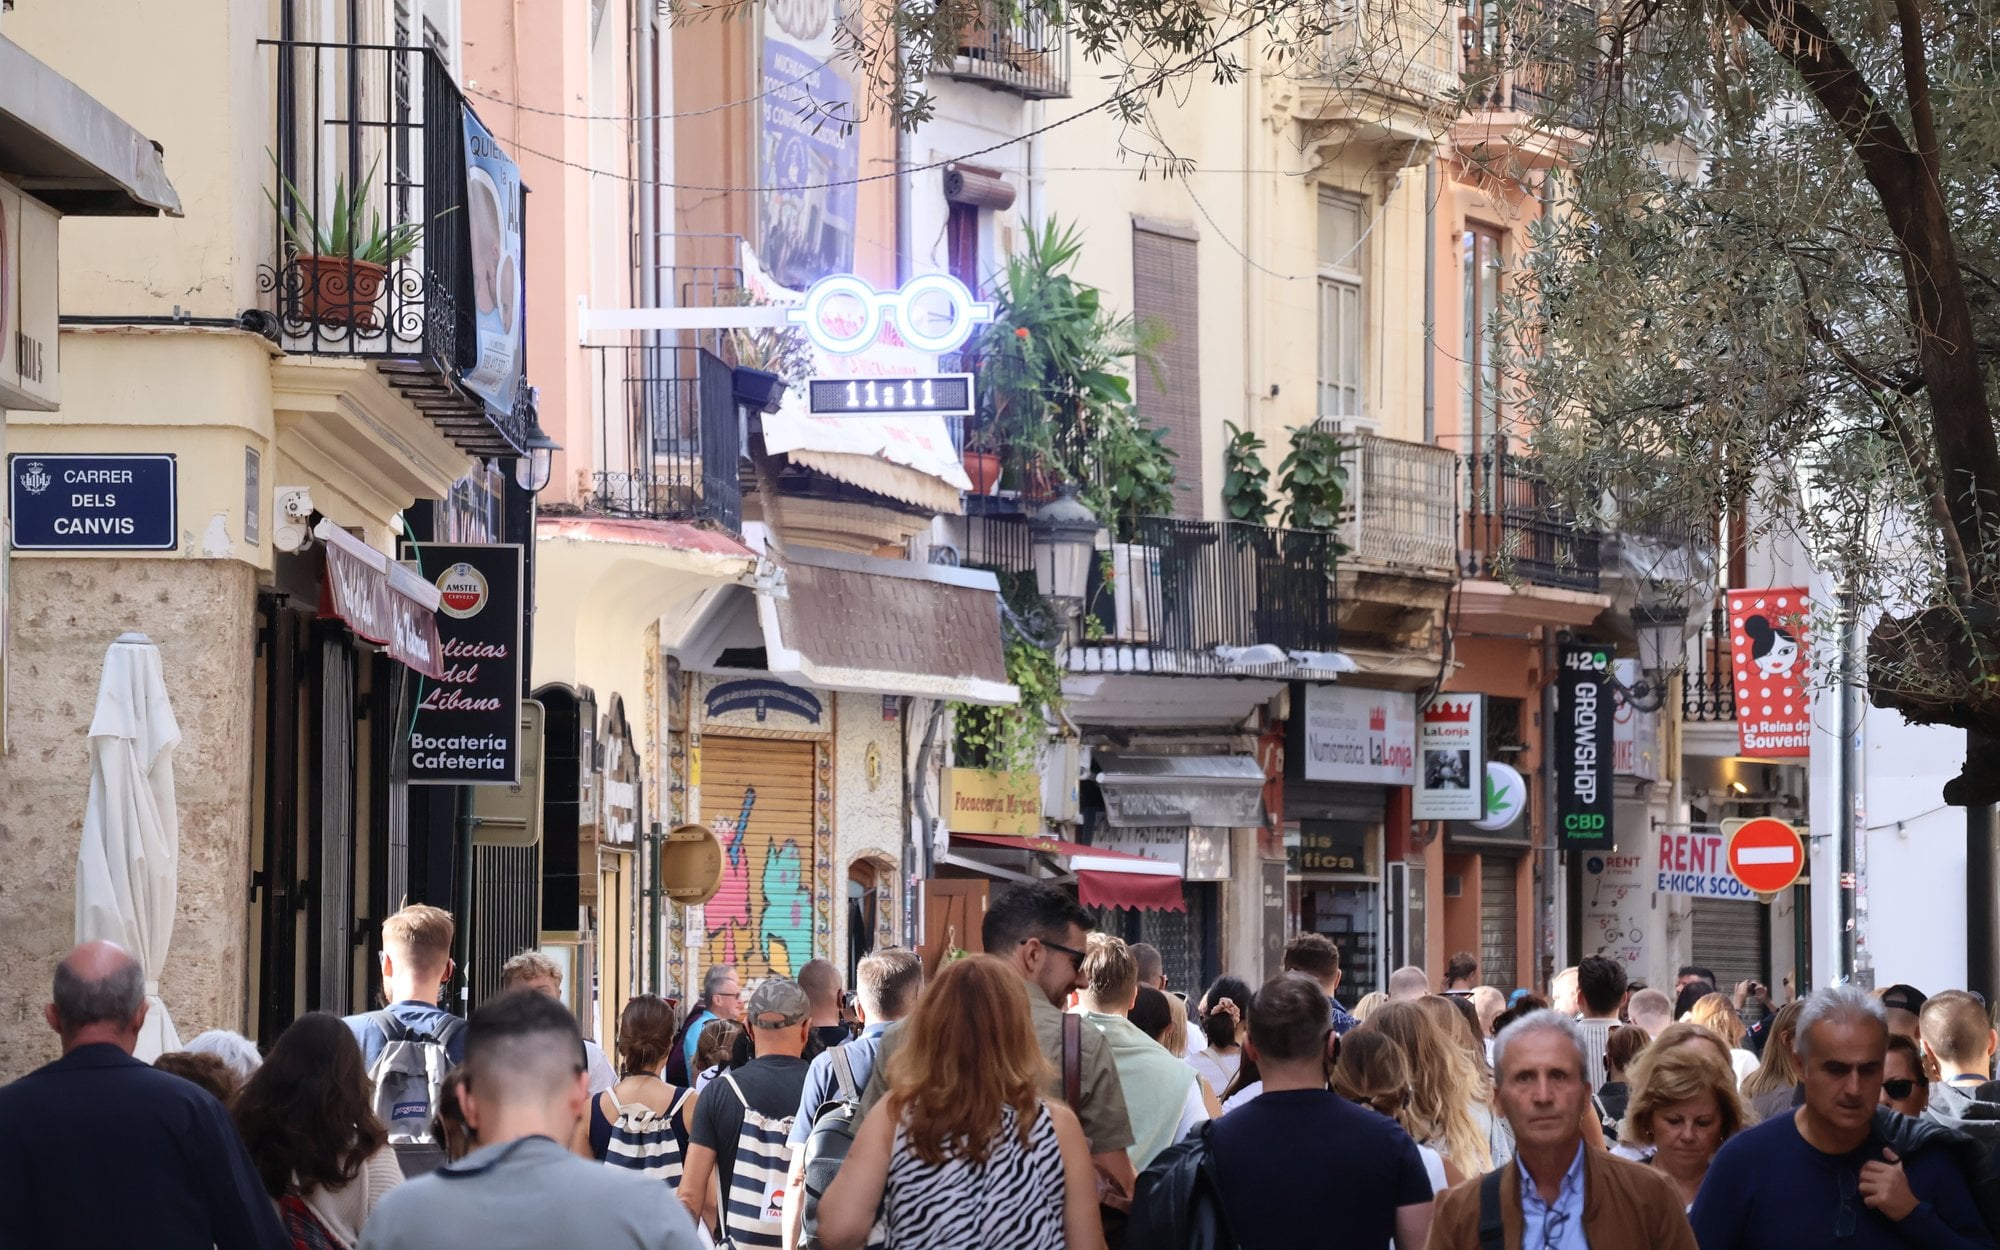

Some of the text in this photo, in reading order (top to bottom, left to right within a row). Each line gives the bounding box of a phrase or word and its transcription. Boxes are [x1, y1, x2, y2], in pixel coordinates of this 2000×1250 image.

[846, 380, 935, 406] 11:11
[64, 470, 133, 484] CARRER
[71, 494, 116, 507] DELS
[54, 518, 135, 535] CANVIS
[1565, 652, 1607, 671] 420
[441, 664, 479, 684] del
[417, 687, 502, 712] Líbano
[1424, 727, 1469, 738] LaLonja
[1742, 721, 1758, 734] La
[1759, 720, 1794, 733] Reina
[411, 733, 508, 751] Bocatería
[1574, 682, 1598, 804] GROWSHOP
[411, 752, 506, 770] Cafetería
[1370, 736, 1412, 776] LaLonja
[1565, 813, 1605, 830] CBD
[1567, 832, 1603, 840] Premium
[1606, 857, 1641, 868] RENT
[1659, 834, 1721, 875] RENT
[1658, 873, 1706, 893] E-KICK
